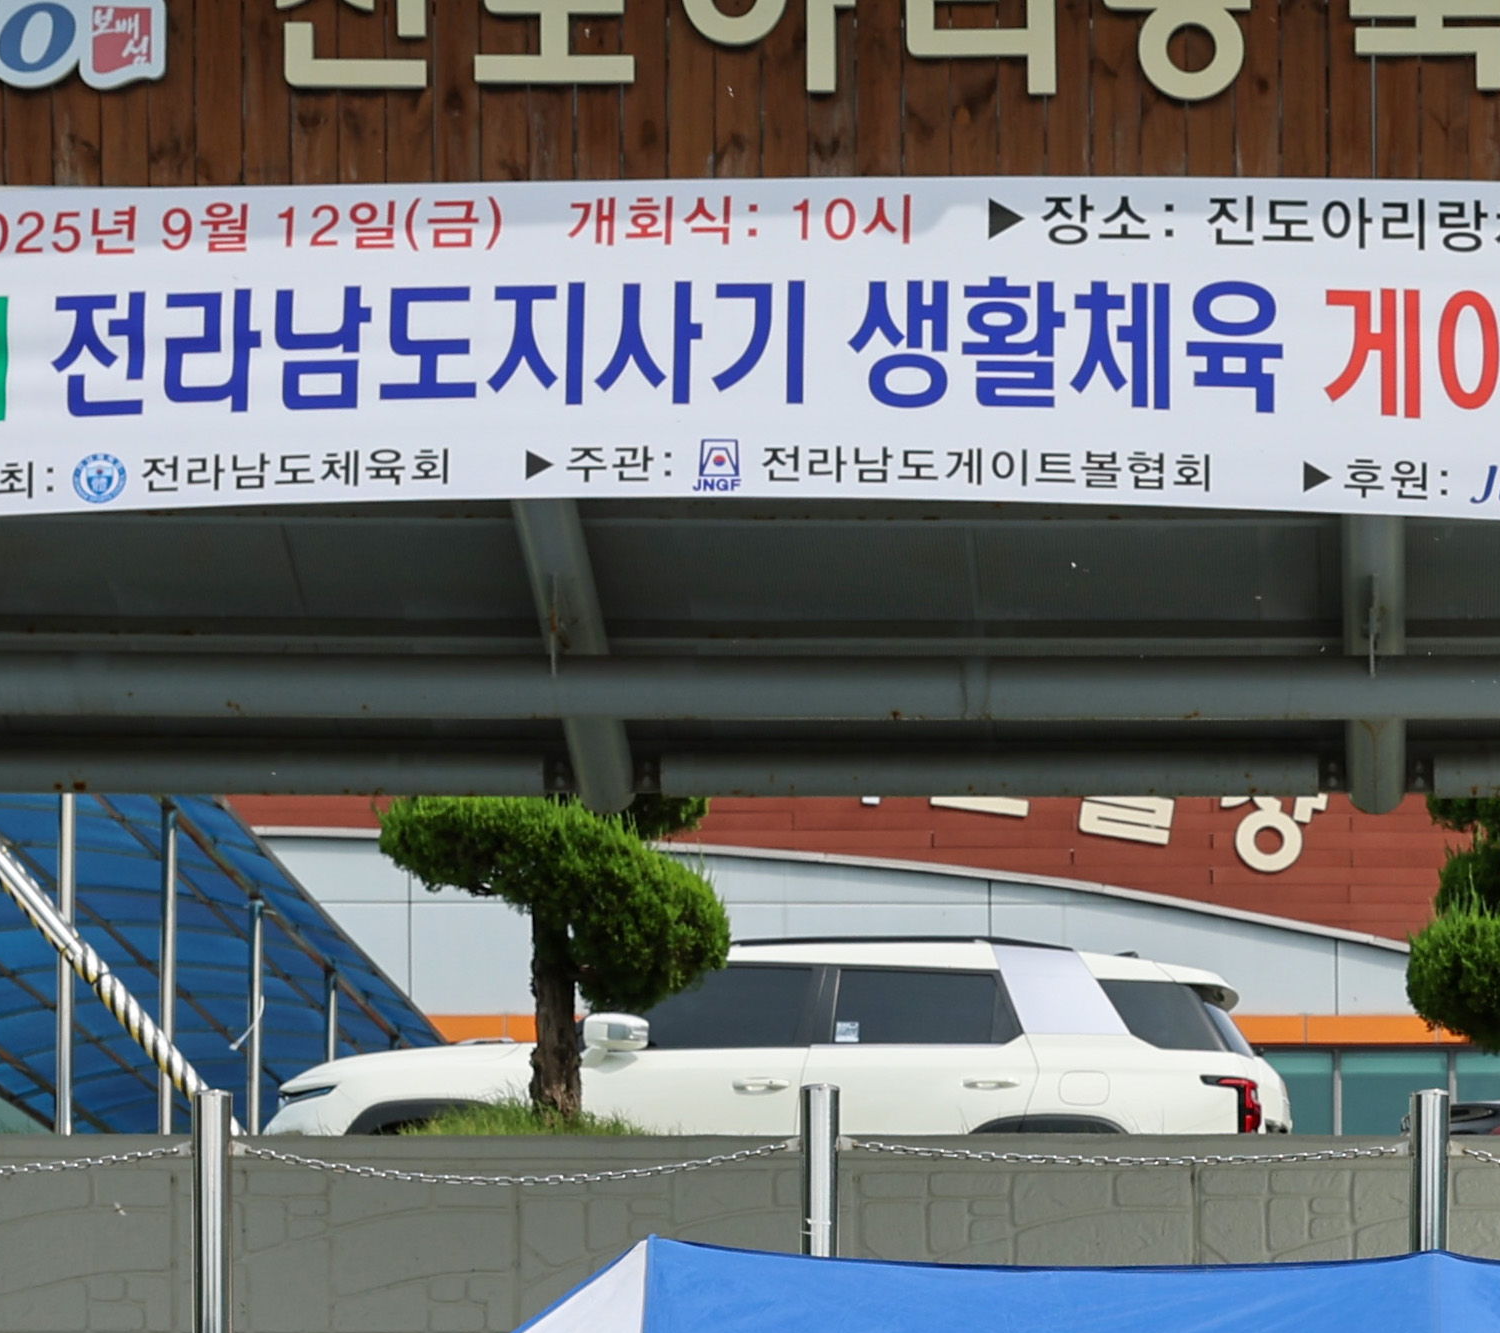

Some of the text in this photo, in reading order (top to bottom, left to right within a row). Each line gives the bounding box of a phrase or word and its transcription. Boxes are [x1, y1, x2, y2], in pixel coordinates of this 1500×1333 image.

[161, 201, 250, 252] 9월
[276, 195, 502, 252] 12일(금)
[567, 195, 759, 246] 개회식:
[790, 194, 914, 244] 10시
[1041, 194, 1176, 246] 장소:
[50, 281, 806, 418] 전라남도지사기
[847, 276, 1284, 414] 생활체육
[140, 447, 451, 493] 전라남도체육회
[565, 446, 674, 484] 주관:
[692, 479, 741, 492] JNGF
[761, 446, 1449, 500] 전라남도게이트볼협회 후원:
